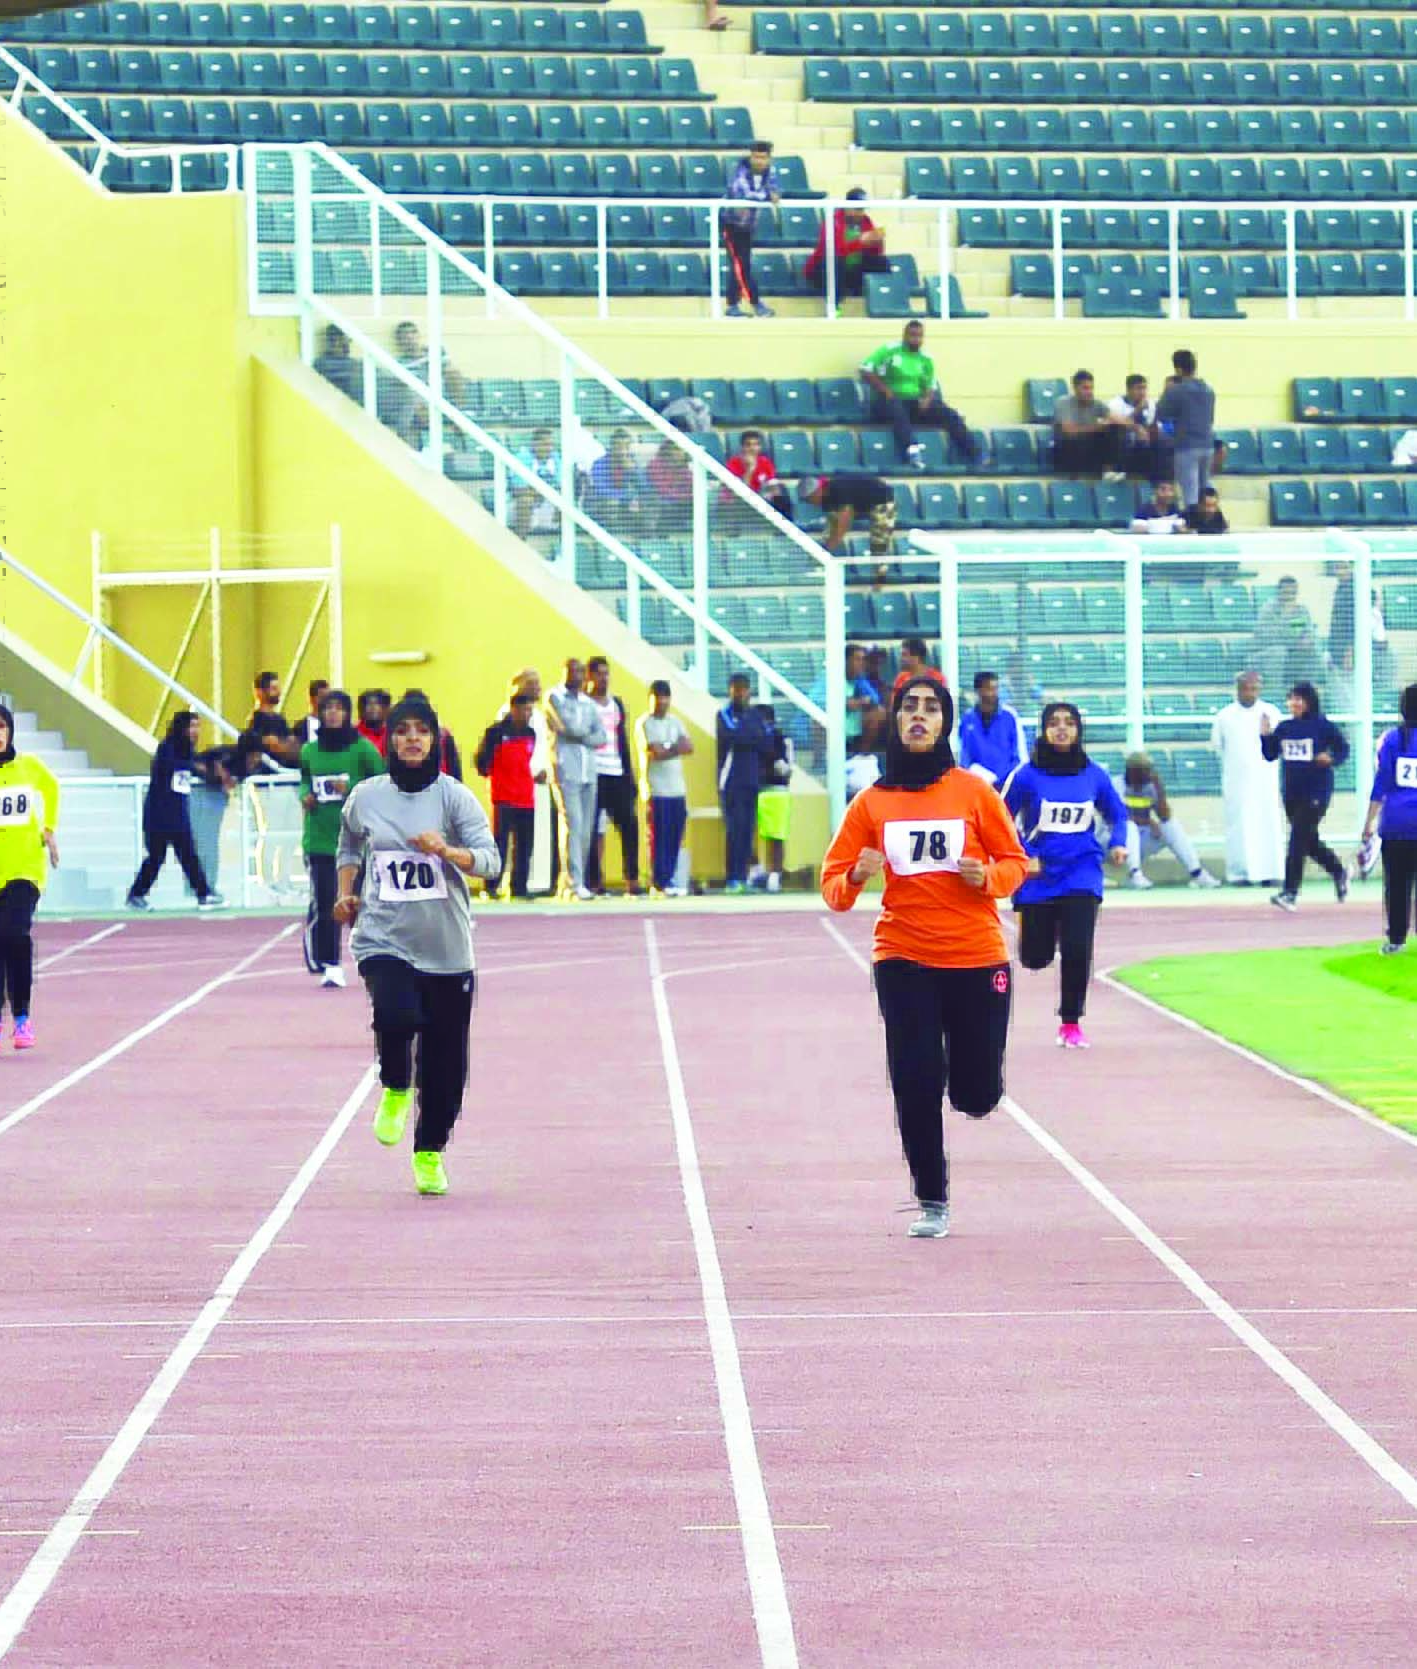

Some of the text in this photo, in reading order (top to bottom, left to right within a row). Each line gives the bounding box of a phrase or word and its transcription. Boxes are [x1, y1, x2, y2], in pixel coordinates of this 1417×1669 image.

[1051, 807, 1085, 825] 197
[909, 830, 947, 862] 78
[387, 860, 435, 890] 120
